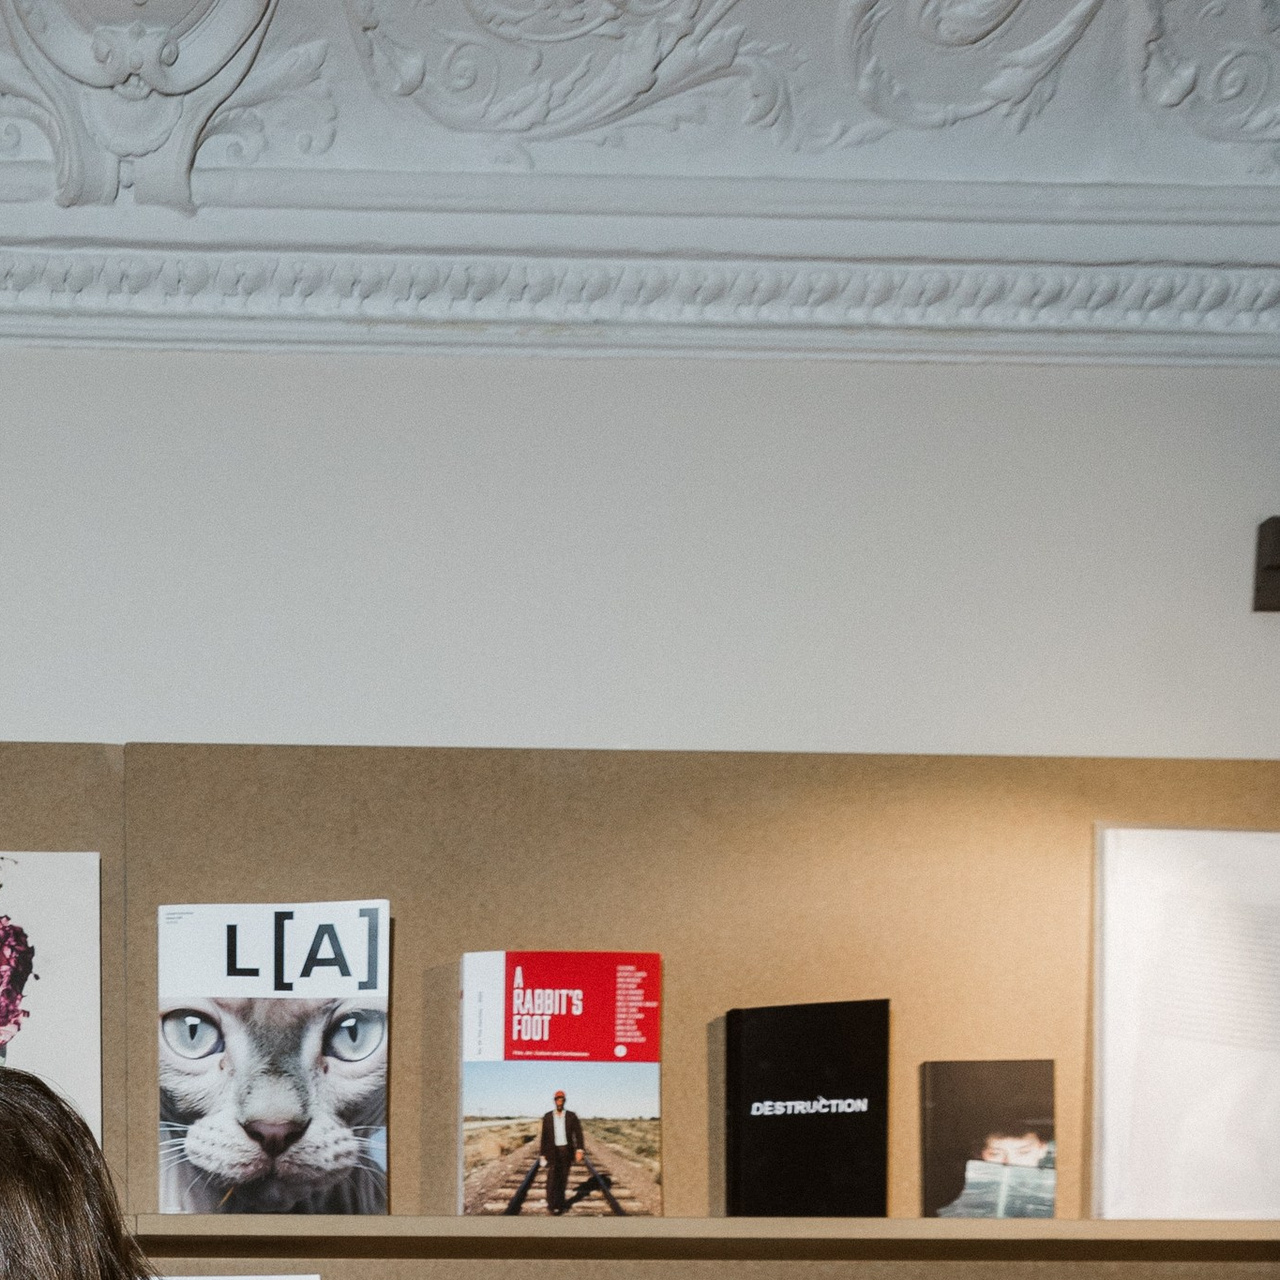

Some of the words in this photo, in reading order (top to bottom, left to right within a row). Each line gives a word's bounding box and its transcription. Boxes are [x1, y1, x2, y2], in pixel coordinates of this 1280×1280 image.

[513, 965, 524, 988] A
[512, 988, 584, 1016] RABBIT'S
[512, 1014, 552, 1042] FOOT
[750, 1097, 869, 1115] DESTRUCTION
